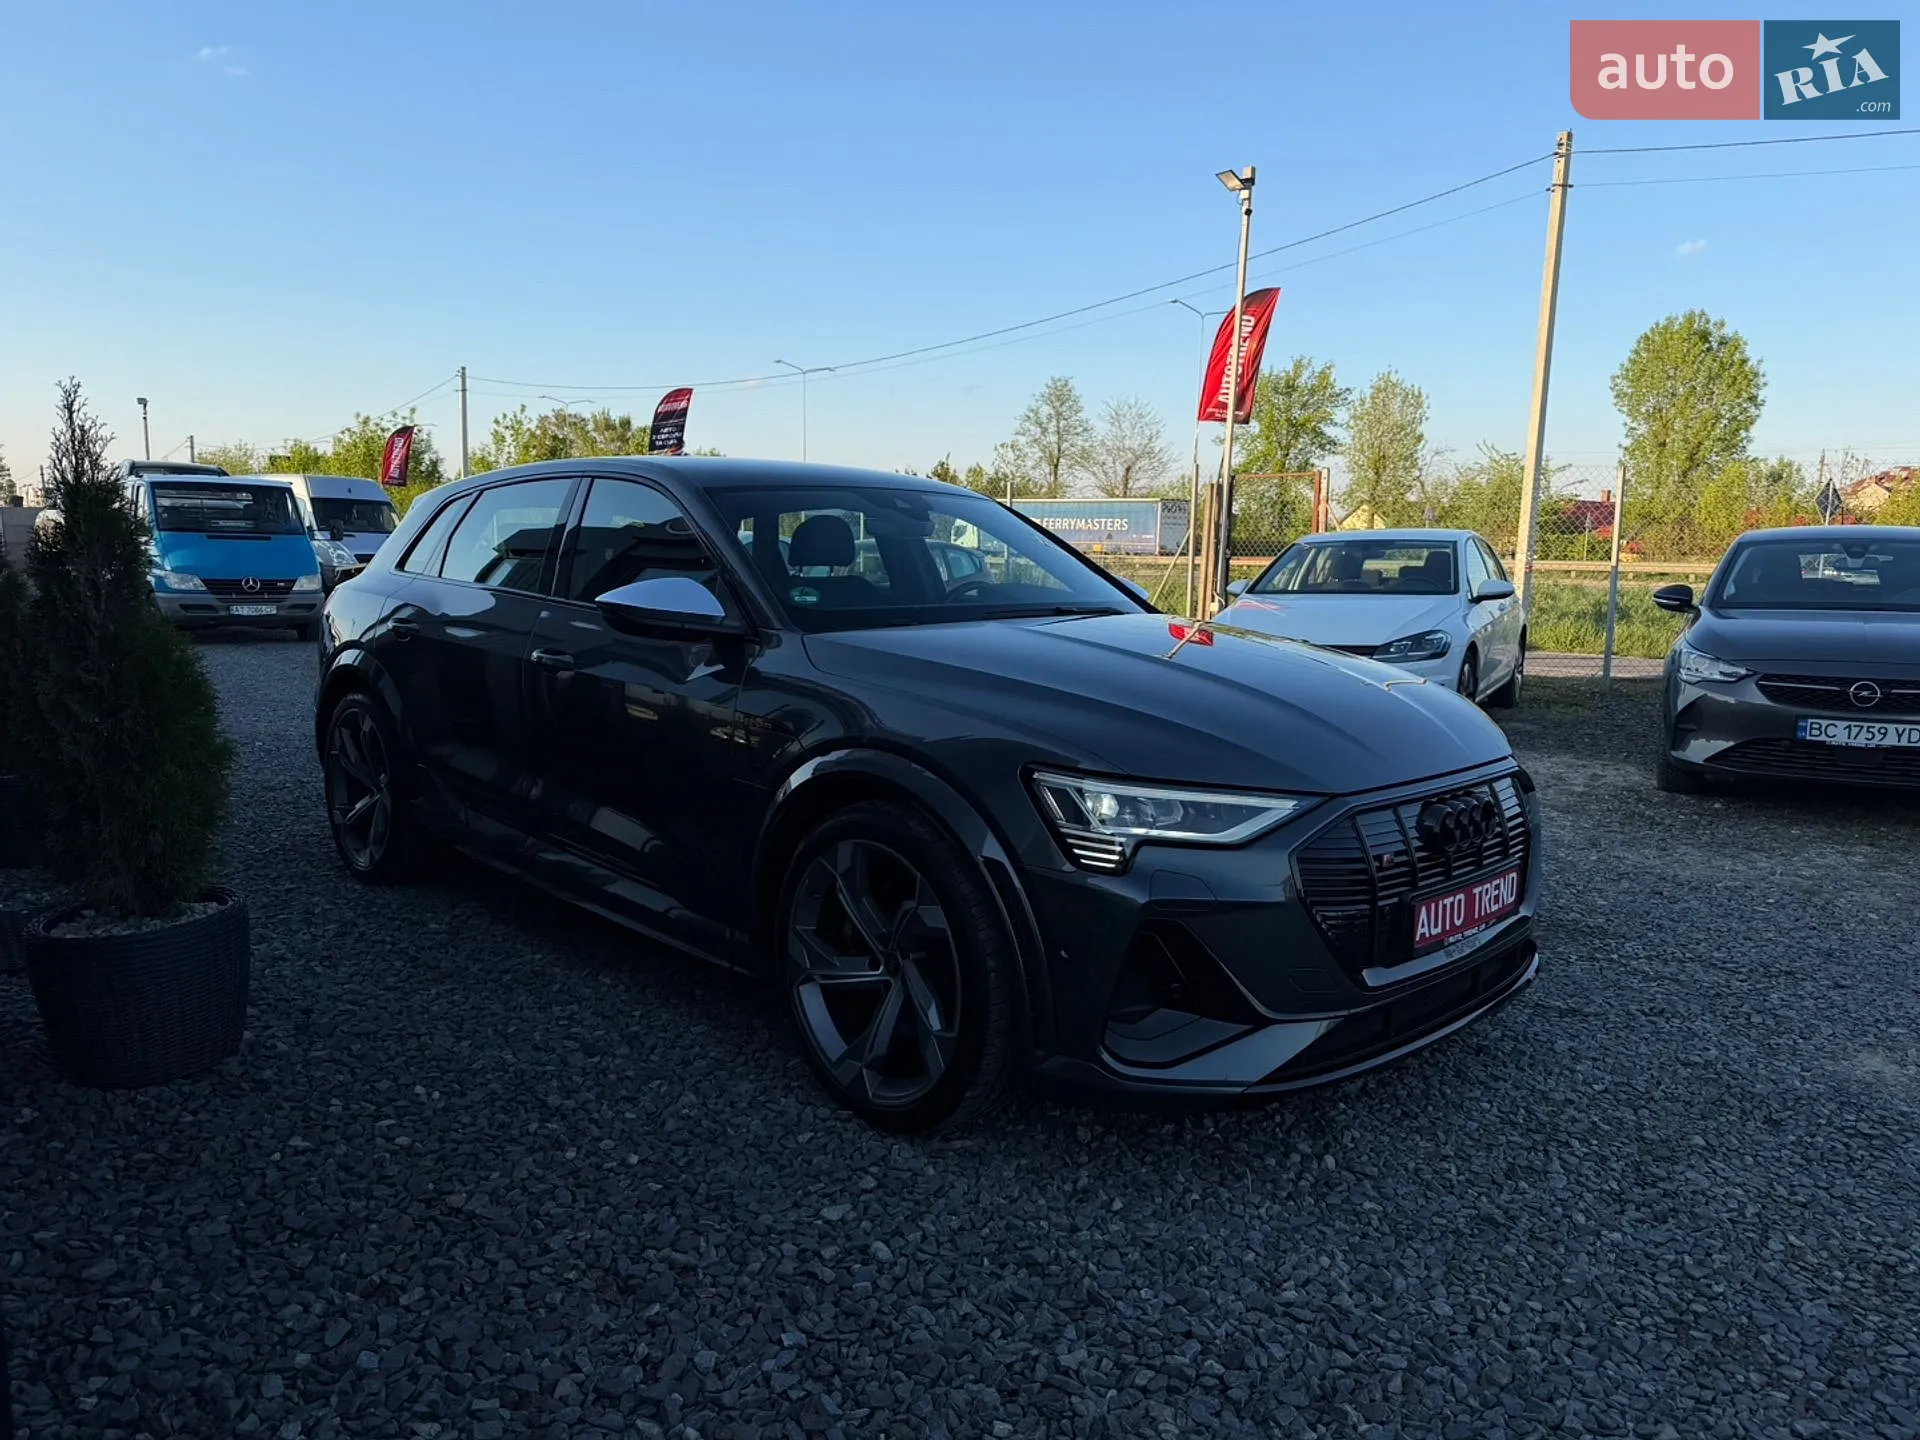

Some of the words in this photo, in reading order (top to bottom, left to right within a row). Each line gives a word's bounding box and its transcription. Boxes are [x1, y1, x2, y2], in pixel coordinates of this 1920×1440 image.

[1042, 518, 1129, 531] FERRYMASTERS
[1808, 721, 1838, 739] BC
[1843, 723, 1888, 741] 1759
[1415, 893, 1465, 942] AUTO
[1472, 871, 1518, 919] TREND
